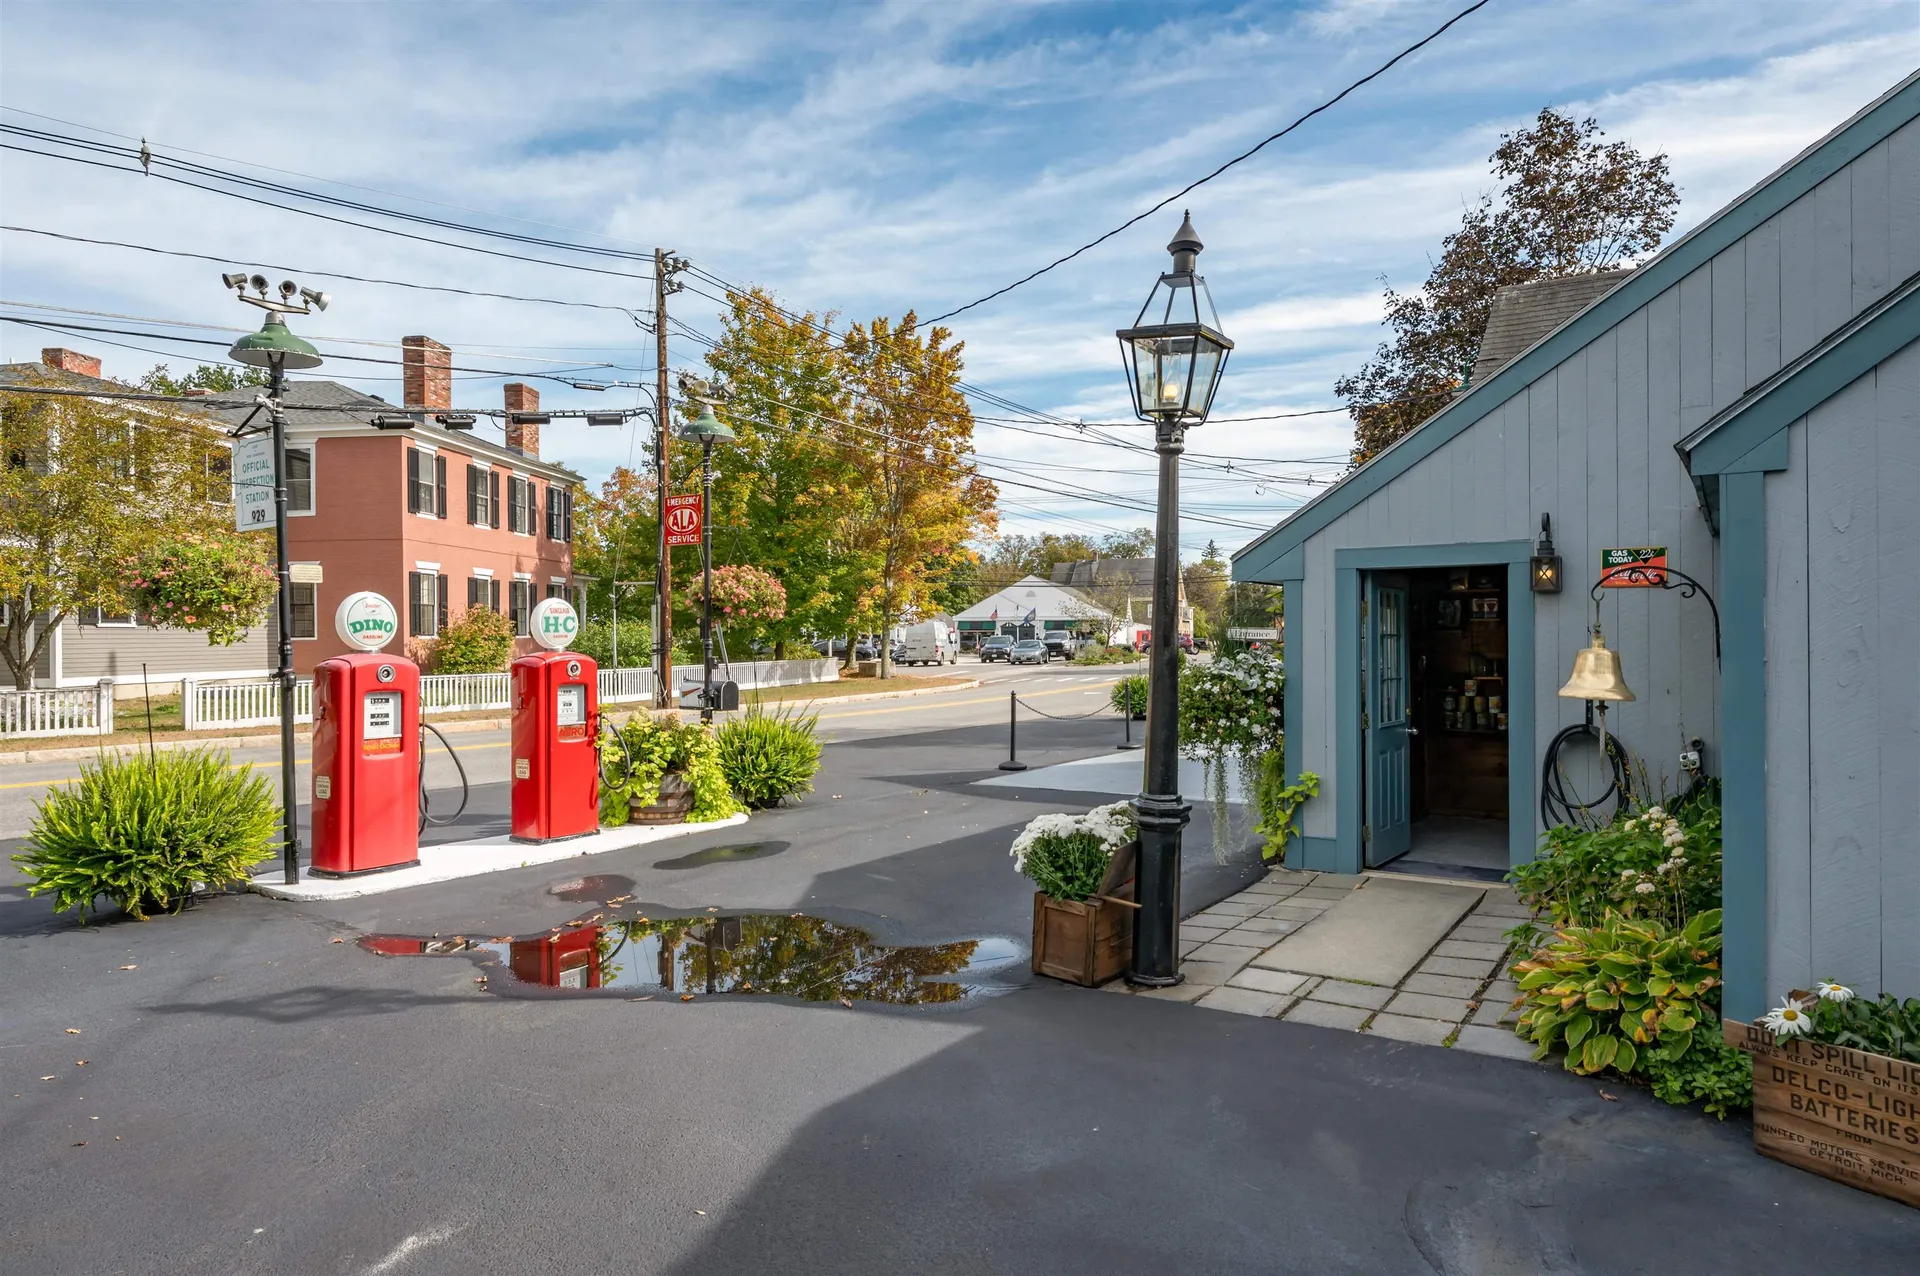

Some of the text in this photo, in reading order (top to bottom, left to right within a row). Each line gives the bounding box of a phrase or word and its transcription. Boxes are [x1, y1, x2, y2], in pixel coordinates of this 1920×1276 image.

[242, 459, 270, 474] OFFICIAL
[240, 473, 275, 490] INSPECTION
[245, 490, 270, 504] STATION
[667, 495, 700, 507] EMERGENCY
[251, 509, 266, 522] 929
[671, 510, 696, 530] ALA
[667, 534, 700, 544] SERVICE
[1608, 556, 1633, 564] TODAY
[1611, 549, 1628, 557] GAS
[349, 618, 394, 634] DINO
[1234, 630, 1271, 638] Entrance
[1811, 1042, 1876, 1075] SPILL
[1739, 1041, 1918, 1096] ALWAYS KEEP CRATE ON ITS
[1790, 1093, 1919, 1145] BATTERIES
[1762, 1123, 1805, 1144] UNITED
[1811, 1139, 1862, 1162] MOTORS
[1836, 1128, 1872, 1146] FROM
